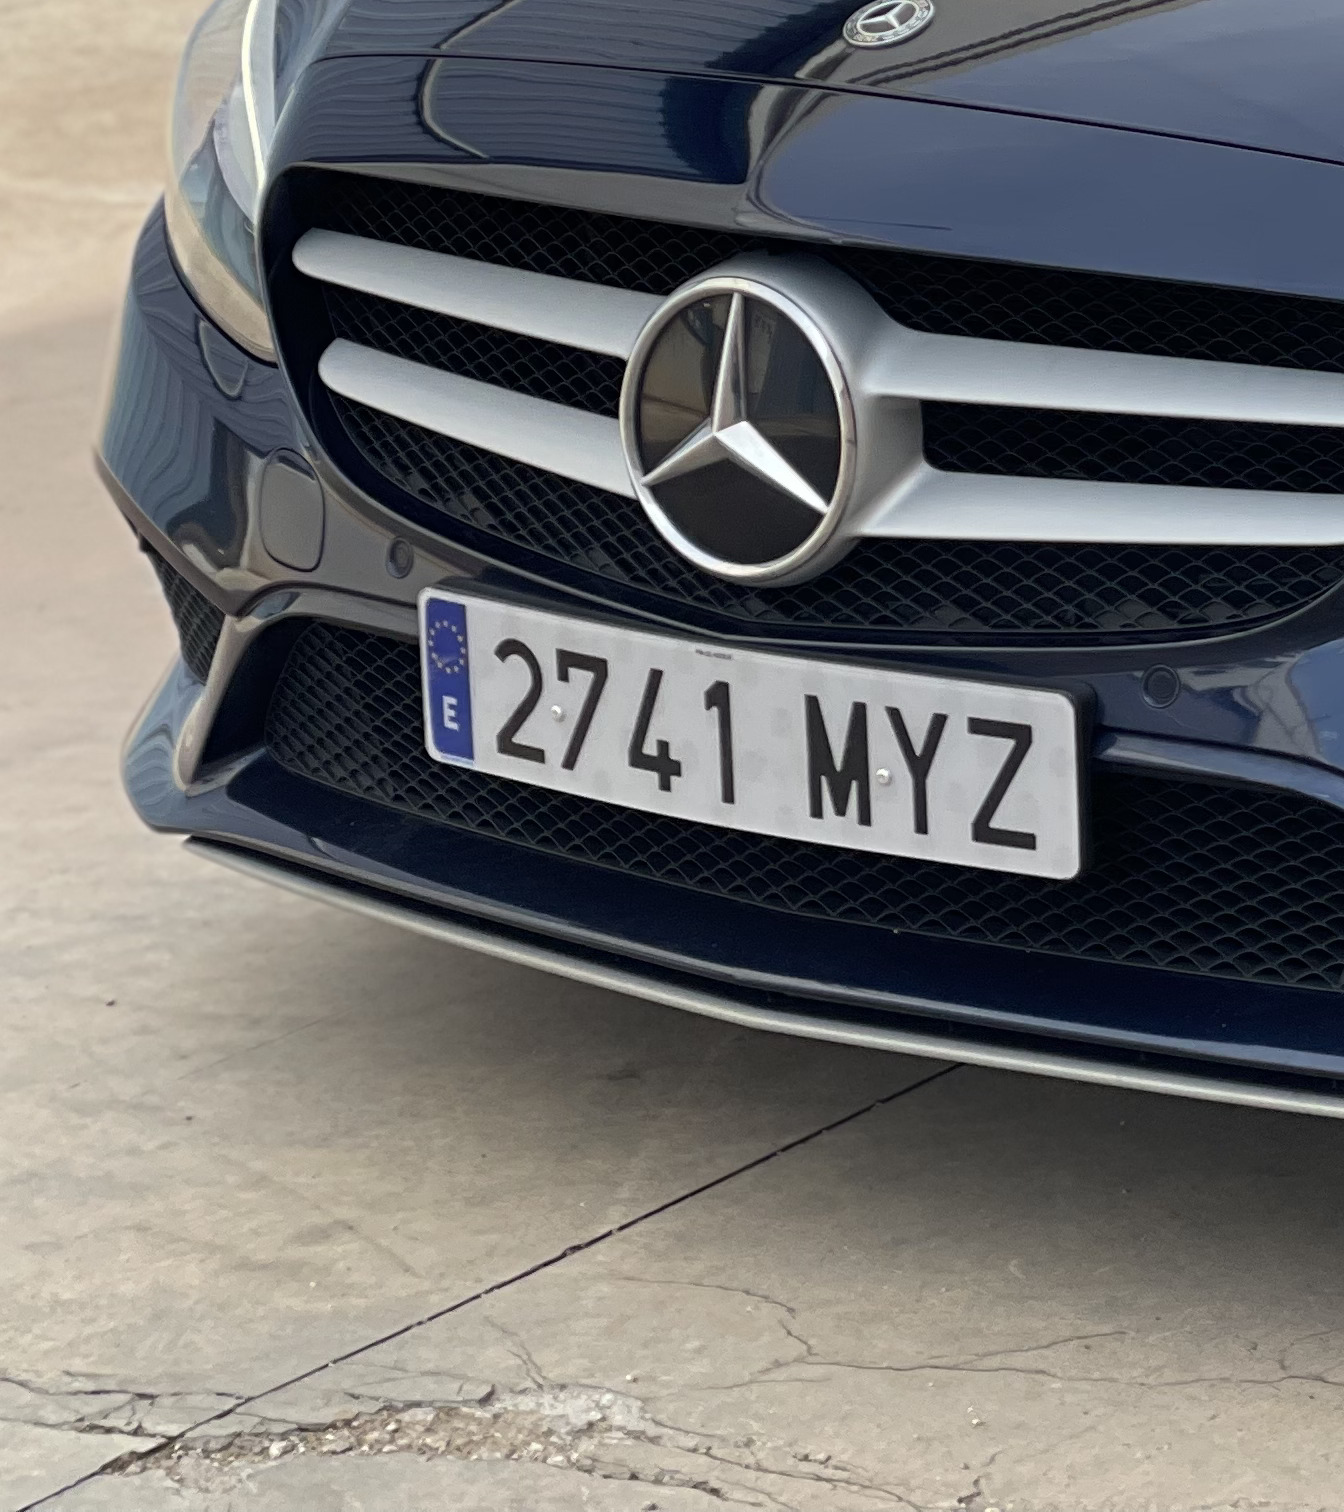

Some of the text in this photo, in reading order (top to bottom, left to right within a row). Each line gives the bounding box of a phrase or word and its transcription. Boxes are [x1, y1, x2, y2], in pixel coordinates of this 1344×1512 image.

[442, 638, 1037, 850] E 2741 MYZ
